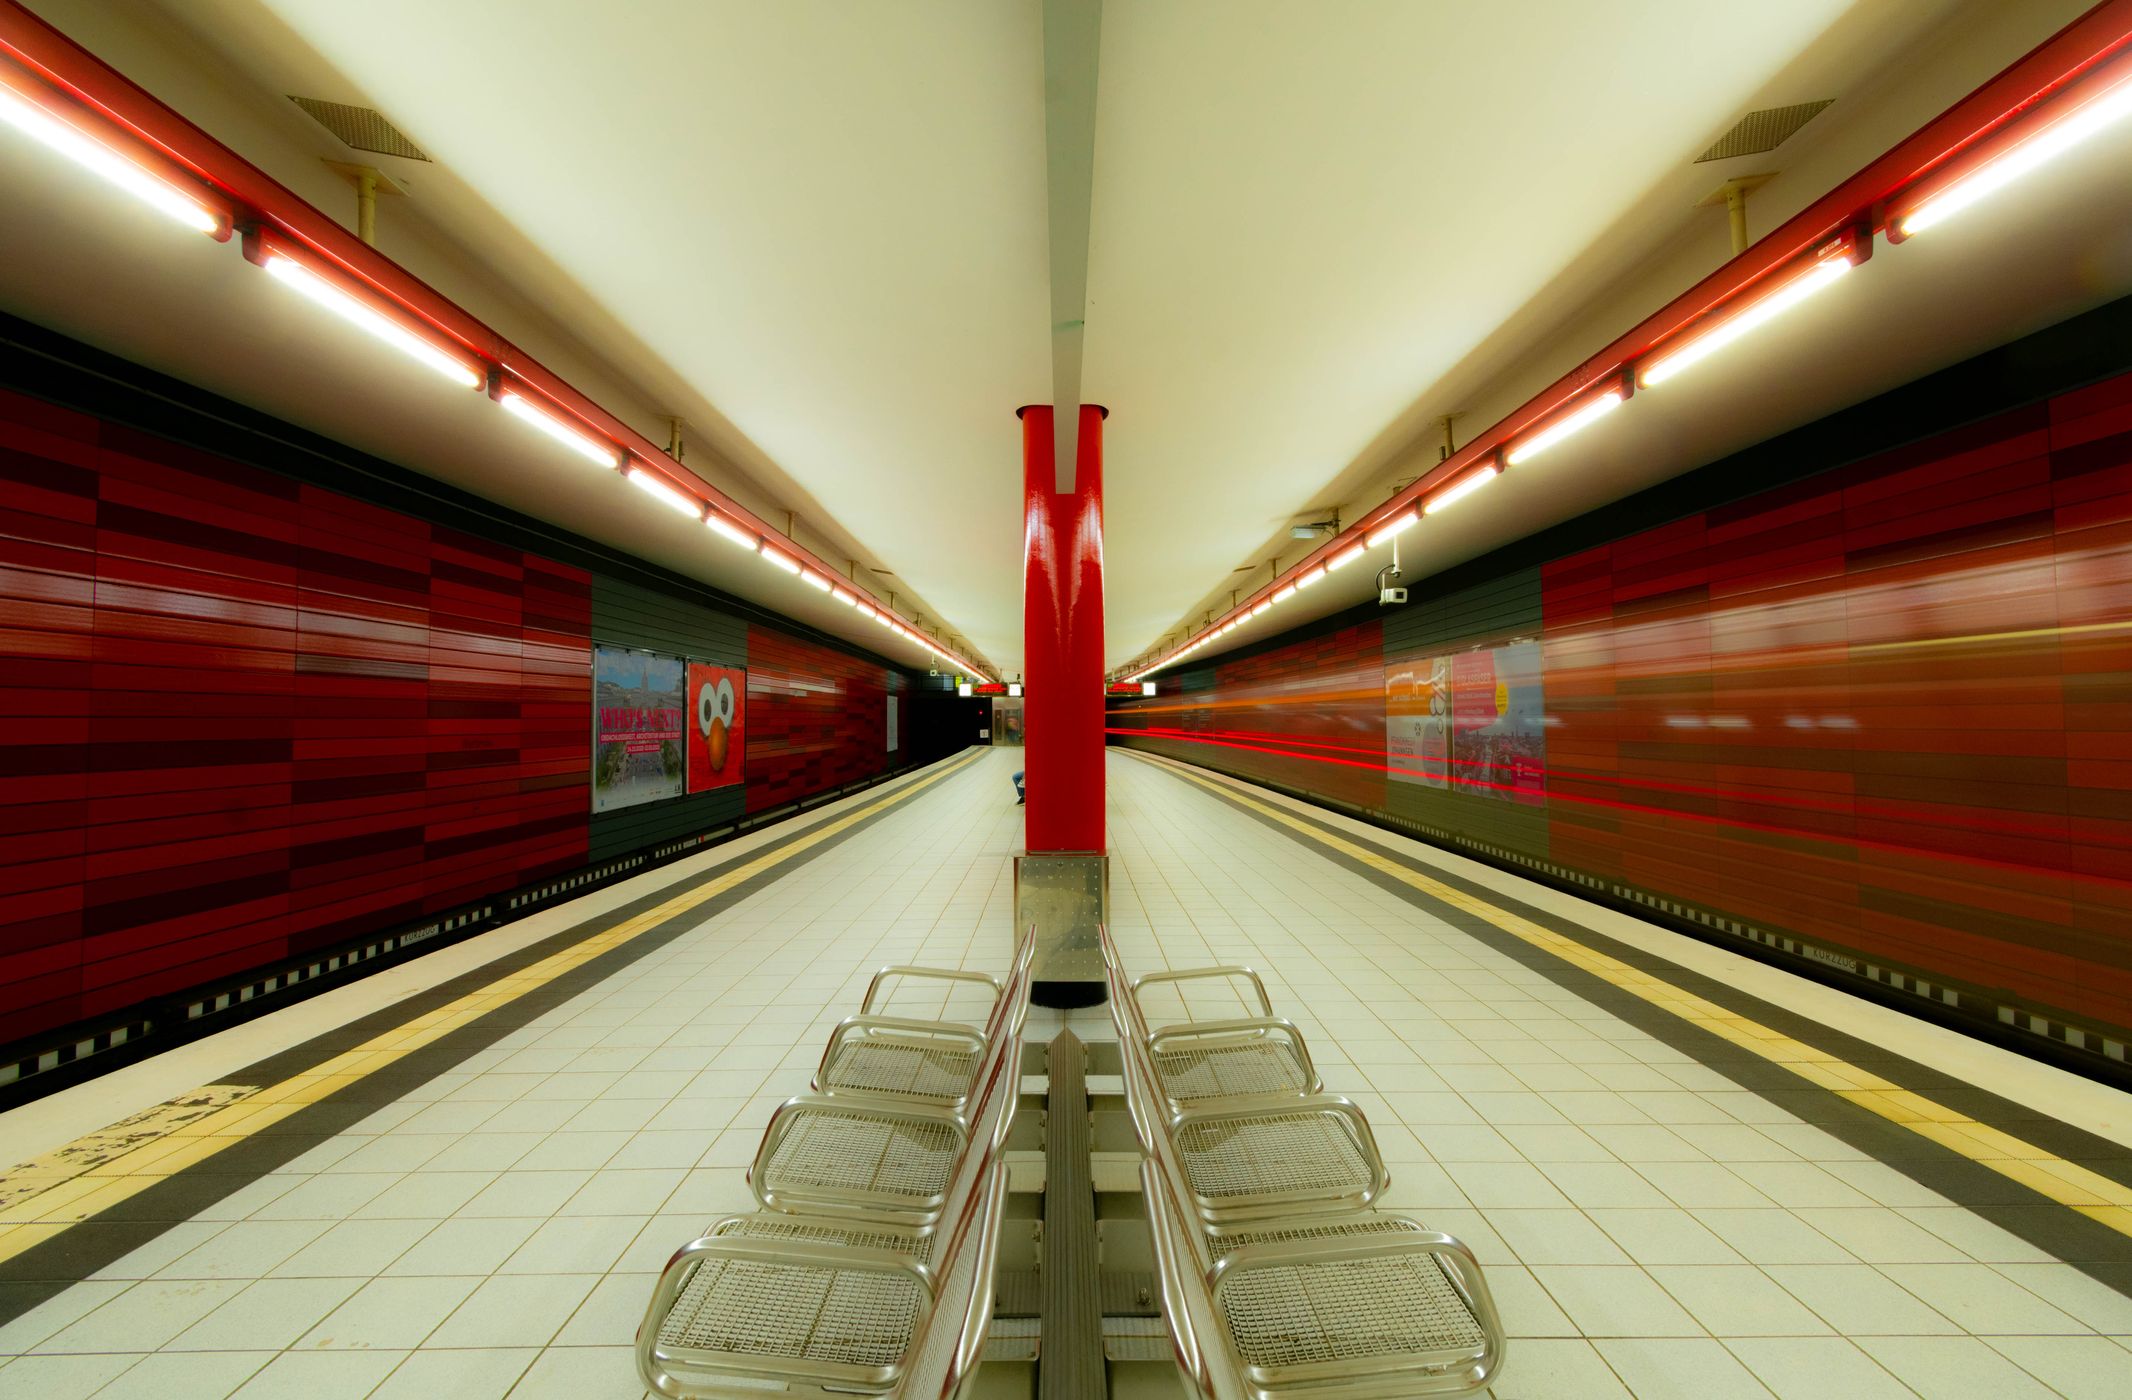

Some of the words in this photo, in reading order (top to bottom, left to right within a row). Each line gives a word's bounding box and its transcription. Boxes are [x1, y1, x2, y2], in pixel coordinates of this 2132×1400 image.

[600, 706, 643, 730] WHO'S
[404, 927, 436, 941] KURZZUG
[1813, 947, 1857, 969] KURZZUG
